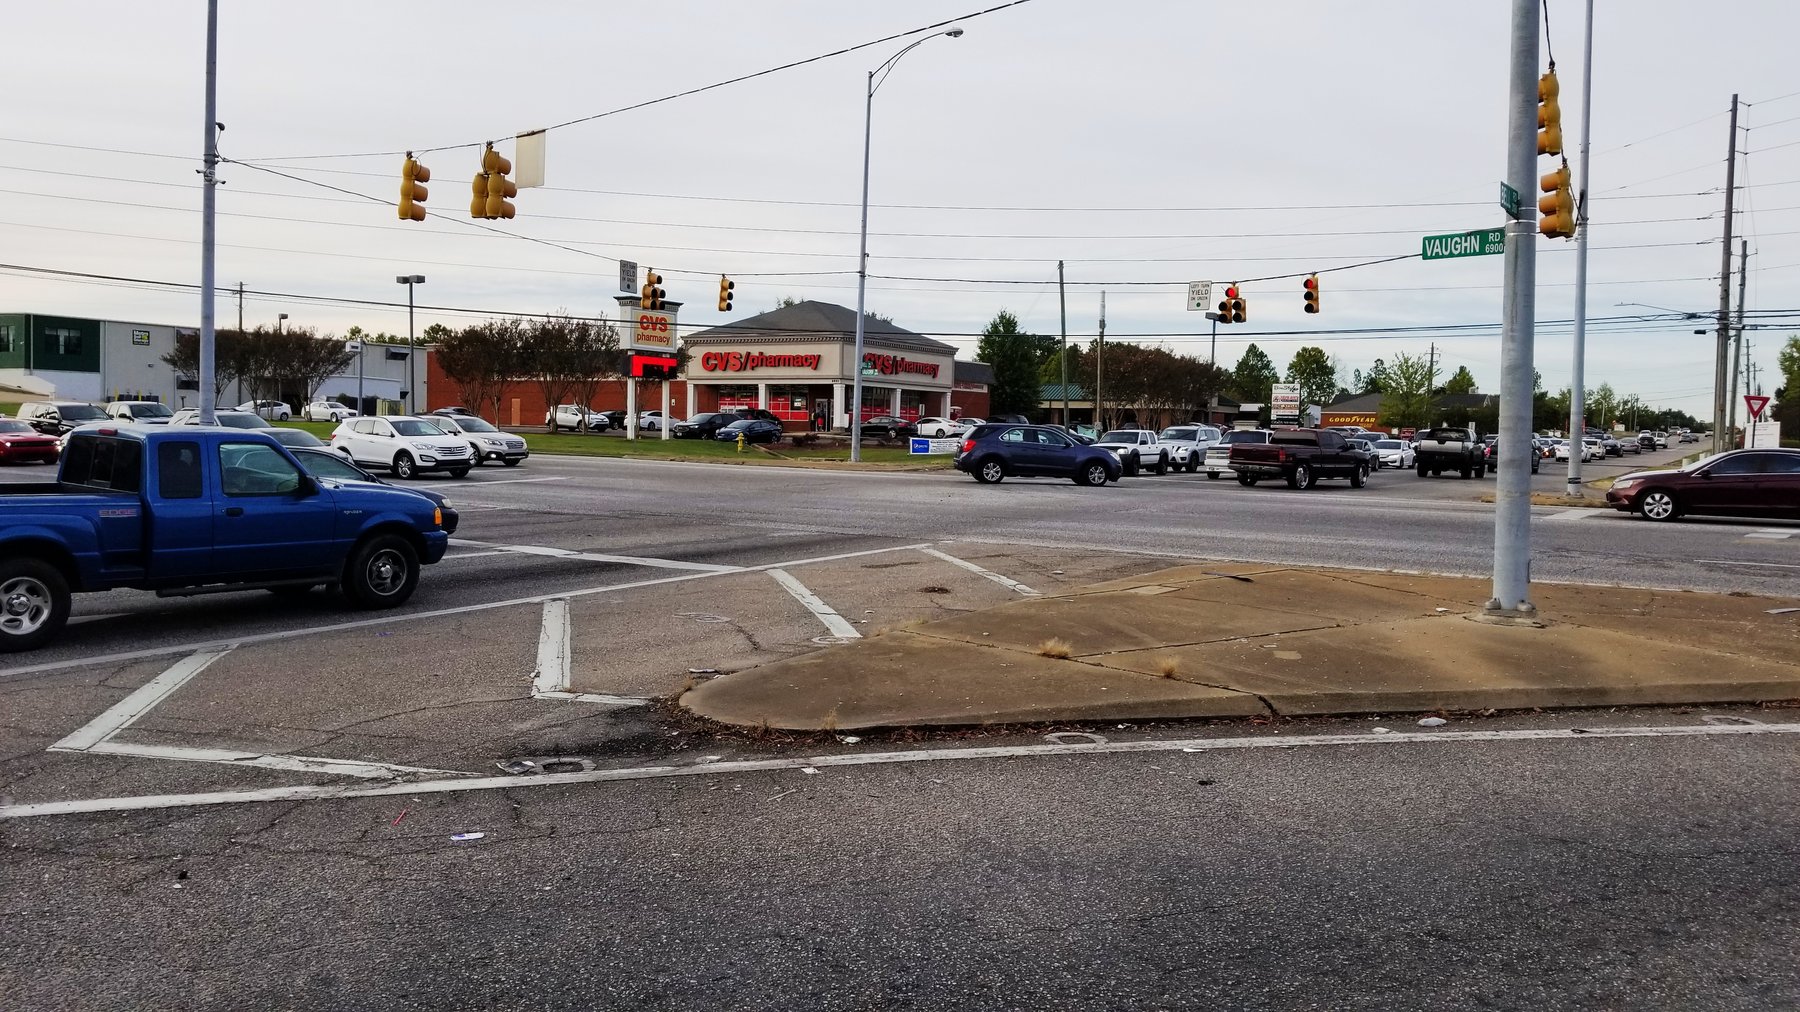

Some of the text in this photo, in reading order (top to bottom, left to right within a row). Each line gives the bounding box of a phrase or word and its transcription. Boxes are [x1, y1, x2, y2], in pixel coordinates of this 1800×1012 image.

[1426, 232, 1501, 257] VAUGHN RD
[1485, 243, 1504, 253] 6900
[621, 269, 636, 277] YIELD
[639, 315, 668, 333] CVS
[636, 333, 671, 346] pharmacy
[1329, 415, 1376, 424] GOODYEAR
[98, 509, 137, 517] EDGE
